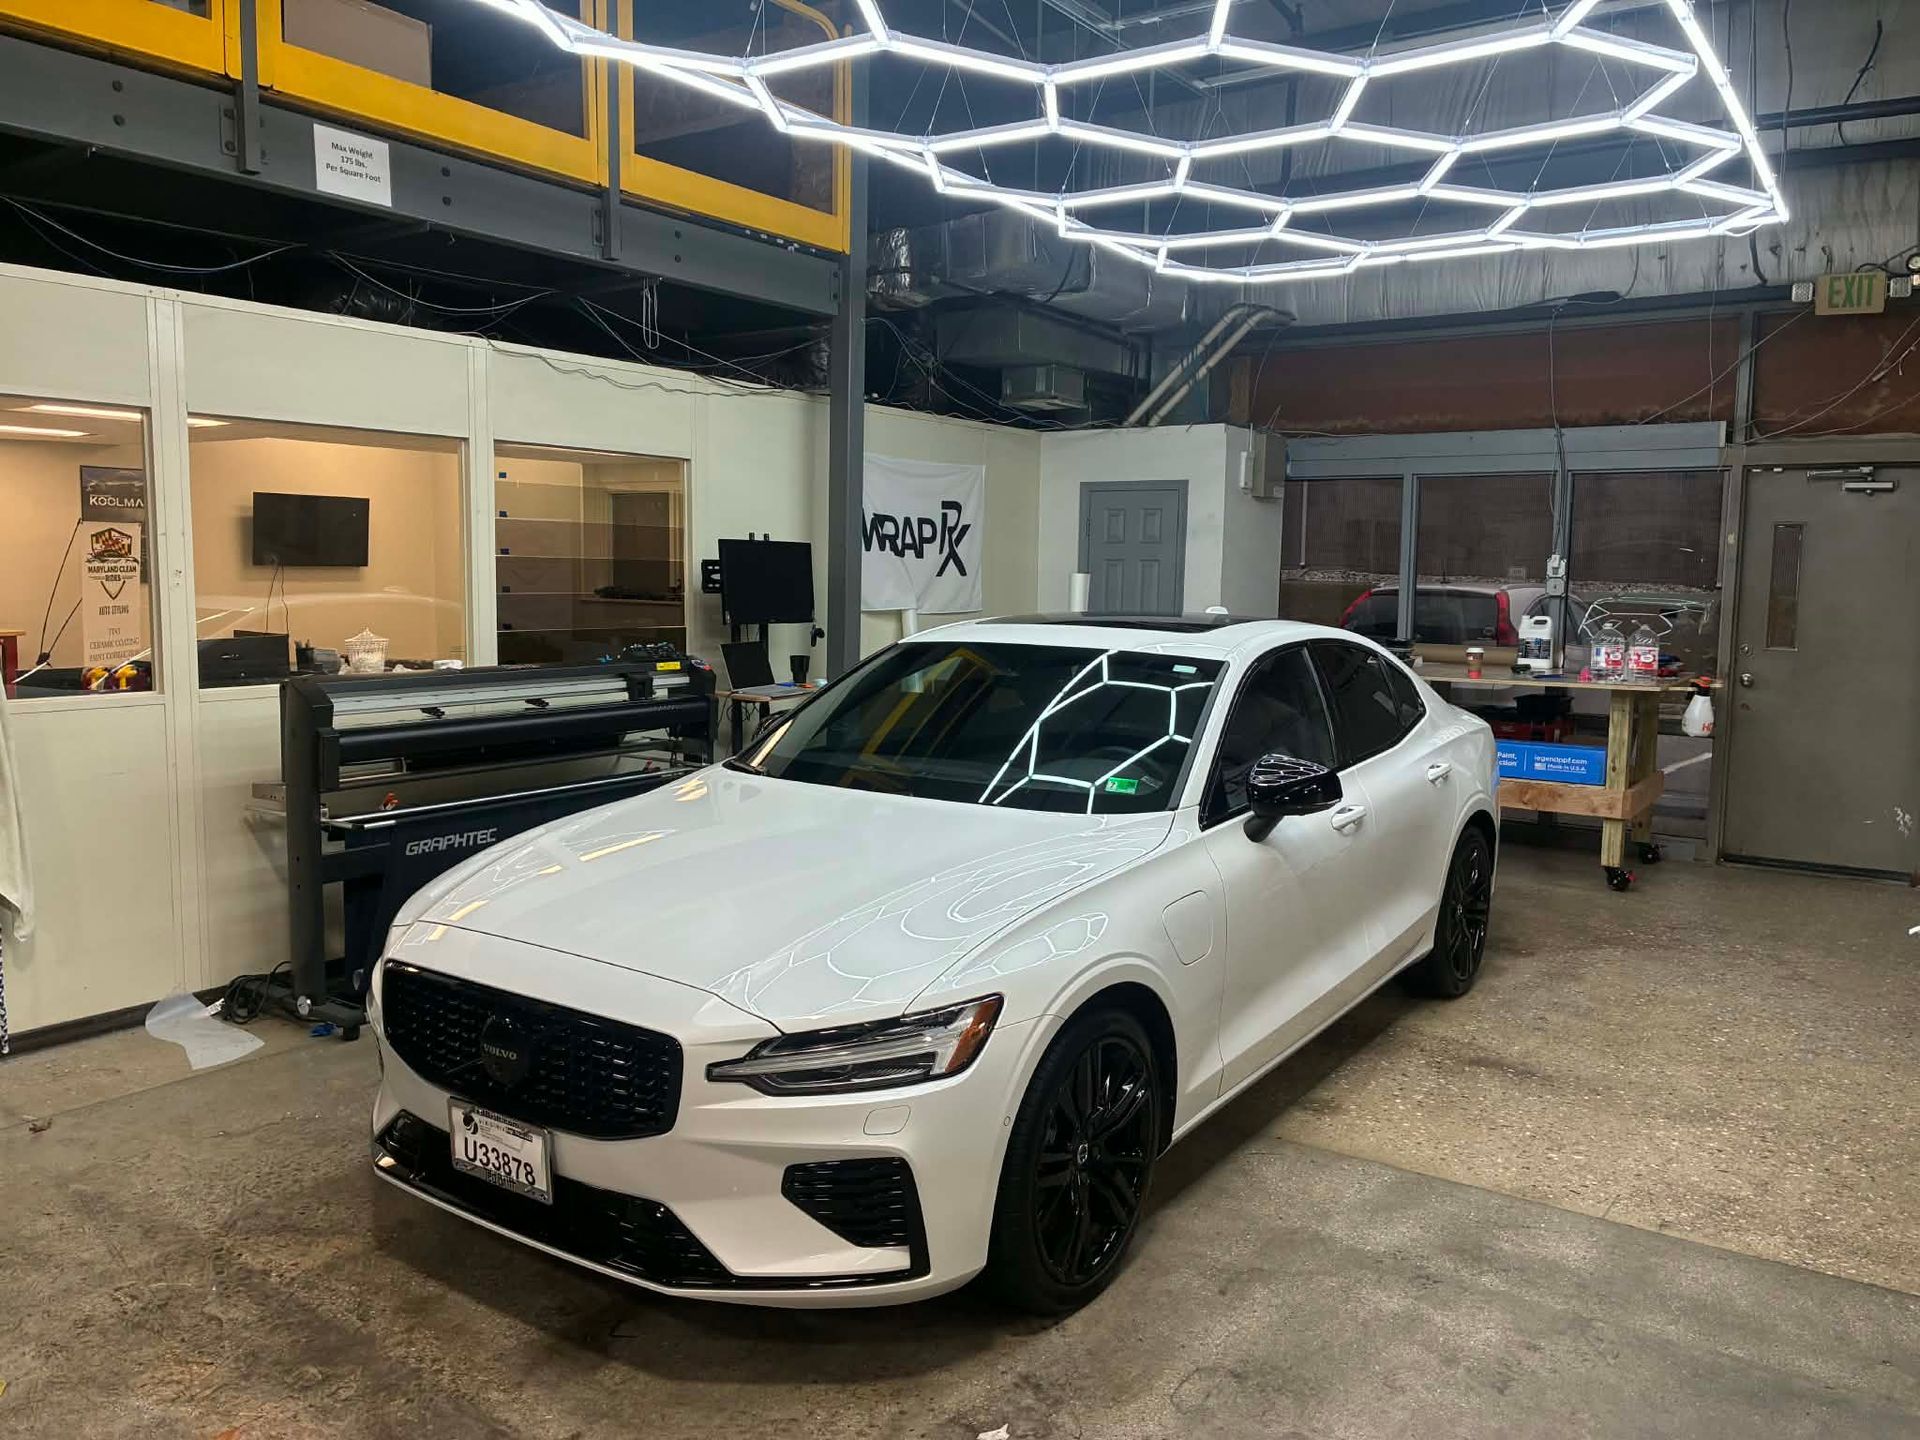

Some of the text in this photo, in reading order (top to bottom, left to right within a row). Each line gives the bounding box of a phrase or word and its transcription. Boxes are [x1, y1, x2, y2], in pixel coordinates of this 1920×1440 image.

[331, 142, 373, 159] Max Weight
[341, 155, 368, 168] 175 lbs.
[326, 162, 381, 183] Per Square Foot
[1828, 274, 1877, 308] EXIT
[88, 565, 137, 573] MARYLAND CLEAN
[1497, 751, 1517, 760] Paint,
[405, 827, 498, 856] GRAPHTEC
[483, 1043, 517, 1060] VOLVO
[464, 1136, 536, 1186] U33878
